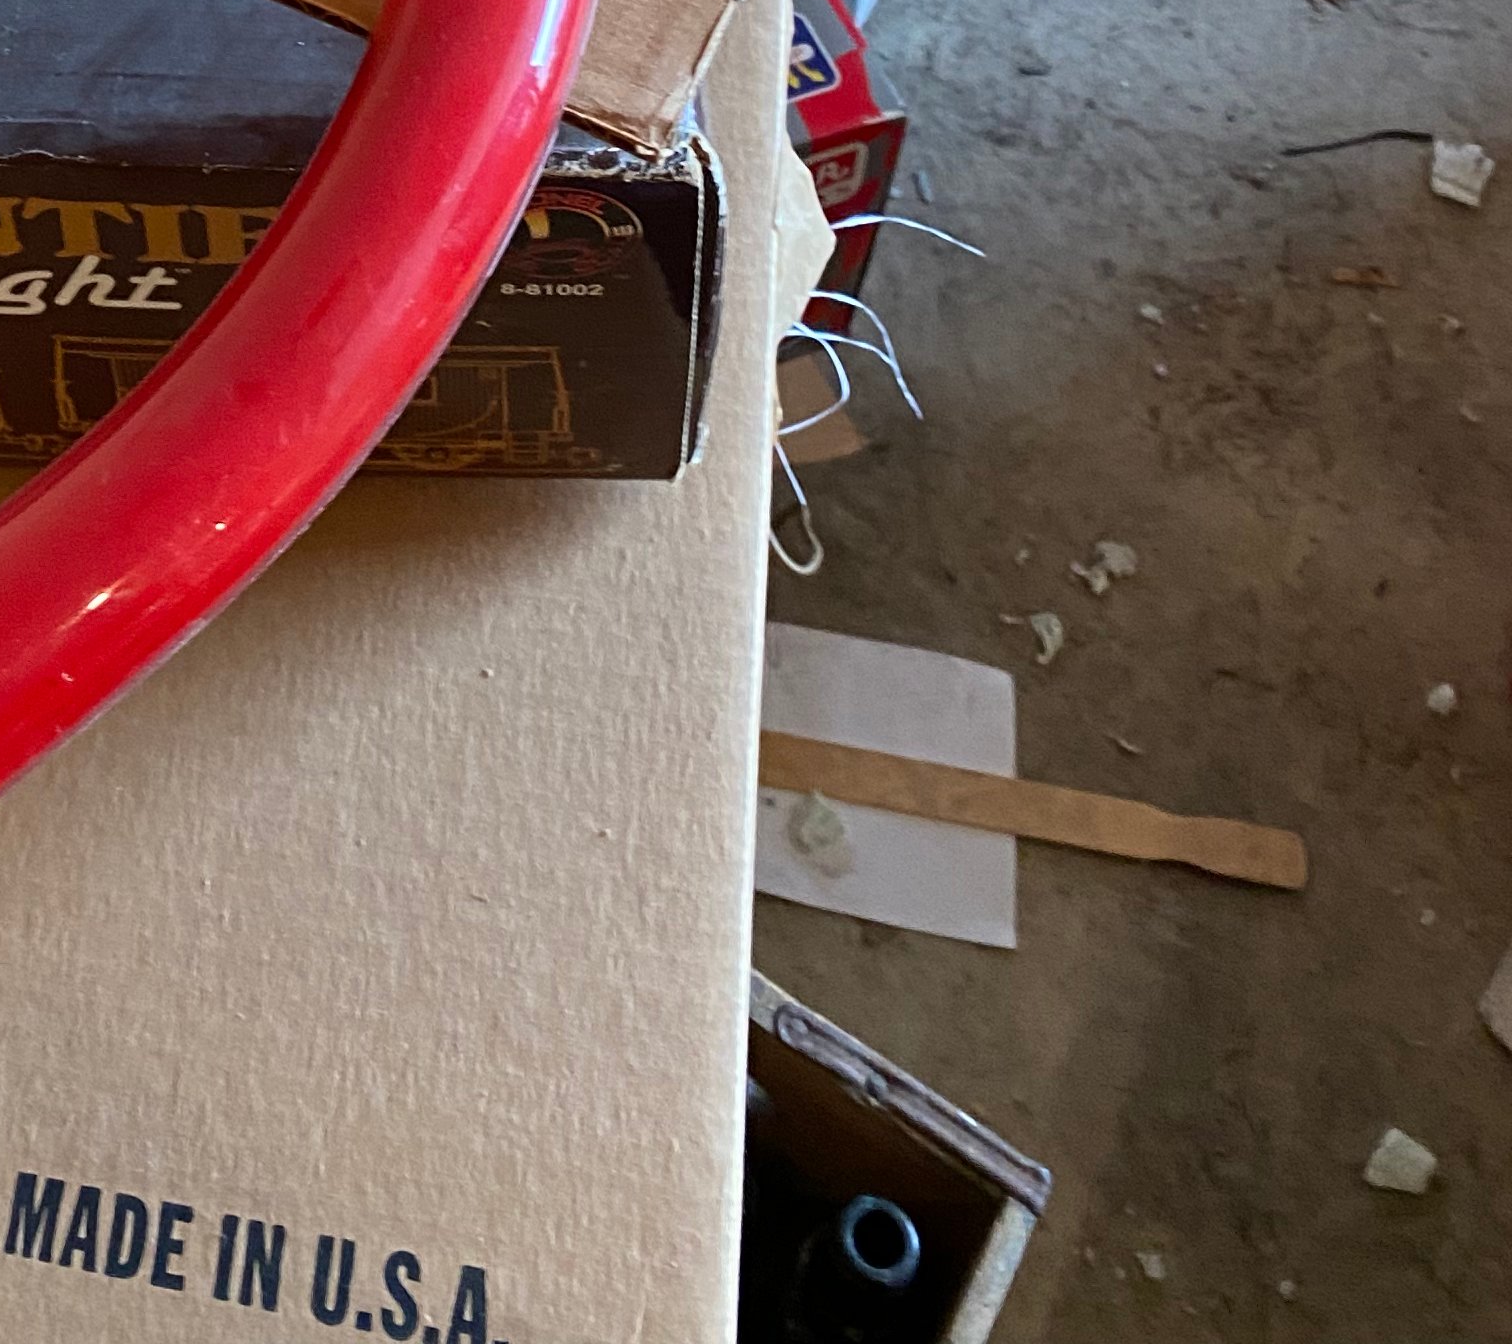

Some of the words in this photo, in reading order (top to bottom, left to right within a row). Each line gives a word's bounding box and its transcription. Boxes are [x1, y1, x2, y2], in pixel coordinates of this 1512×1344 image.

[499, 282, 606, 297] 8-81002
[3, 1171, 195, 1292] MADE
[211, 1214, 286, 1311] IN
[311, 1235, 510, 1344] U.S.A.
